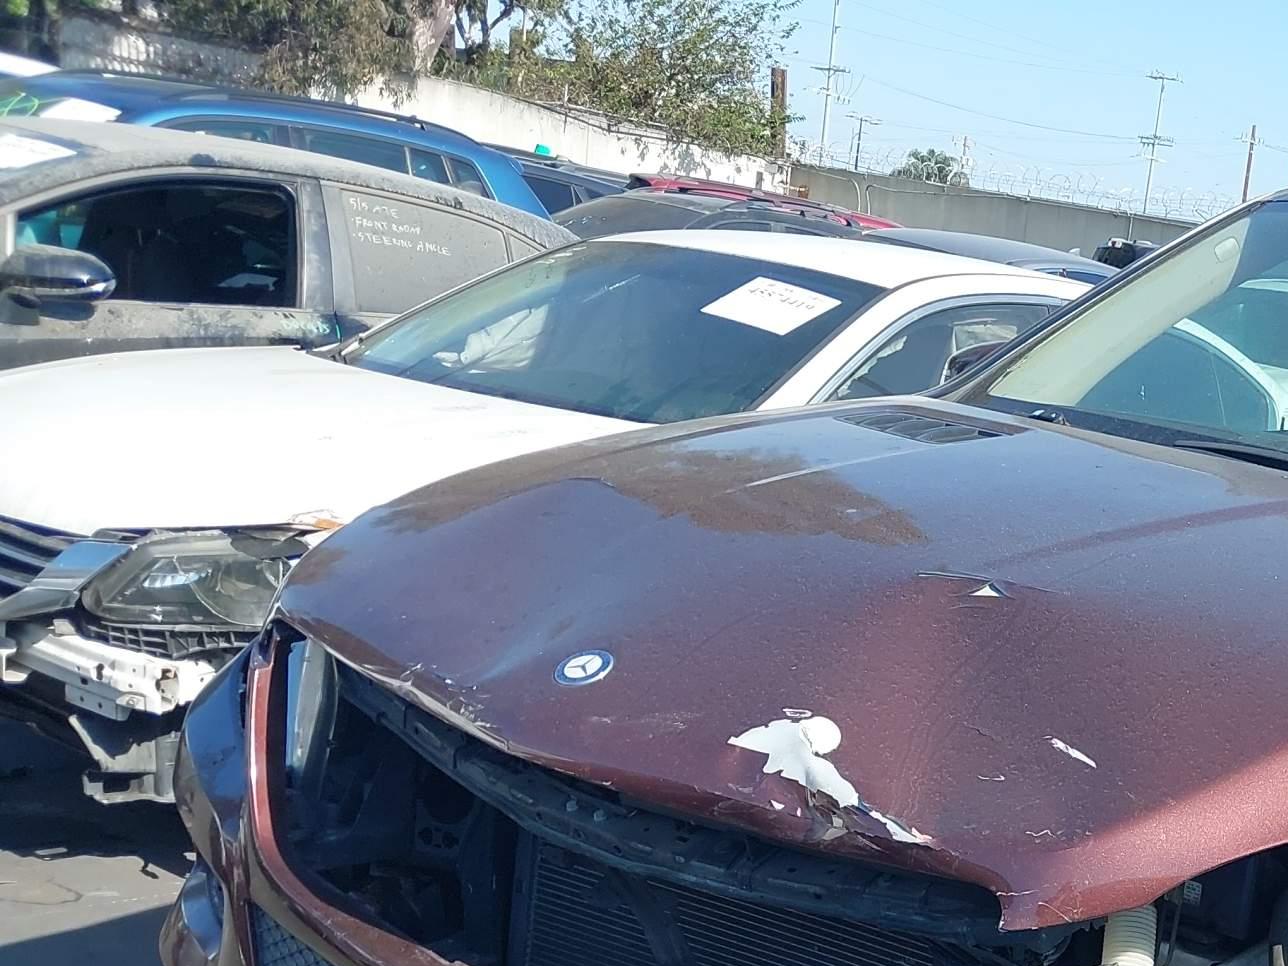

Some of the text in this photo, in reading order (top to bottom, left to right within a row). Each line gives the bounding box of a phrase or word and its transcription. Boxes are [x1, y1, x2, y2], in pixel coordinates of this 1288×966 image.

[355, 216, 388, 231] FRONT
[358, 231, 452, 256] STEERING ANGLE
